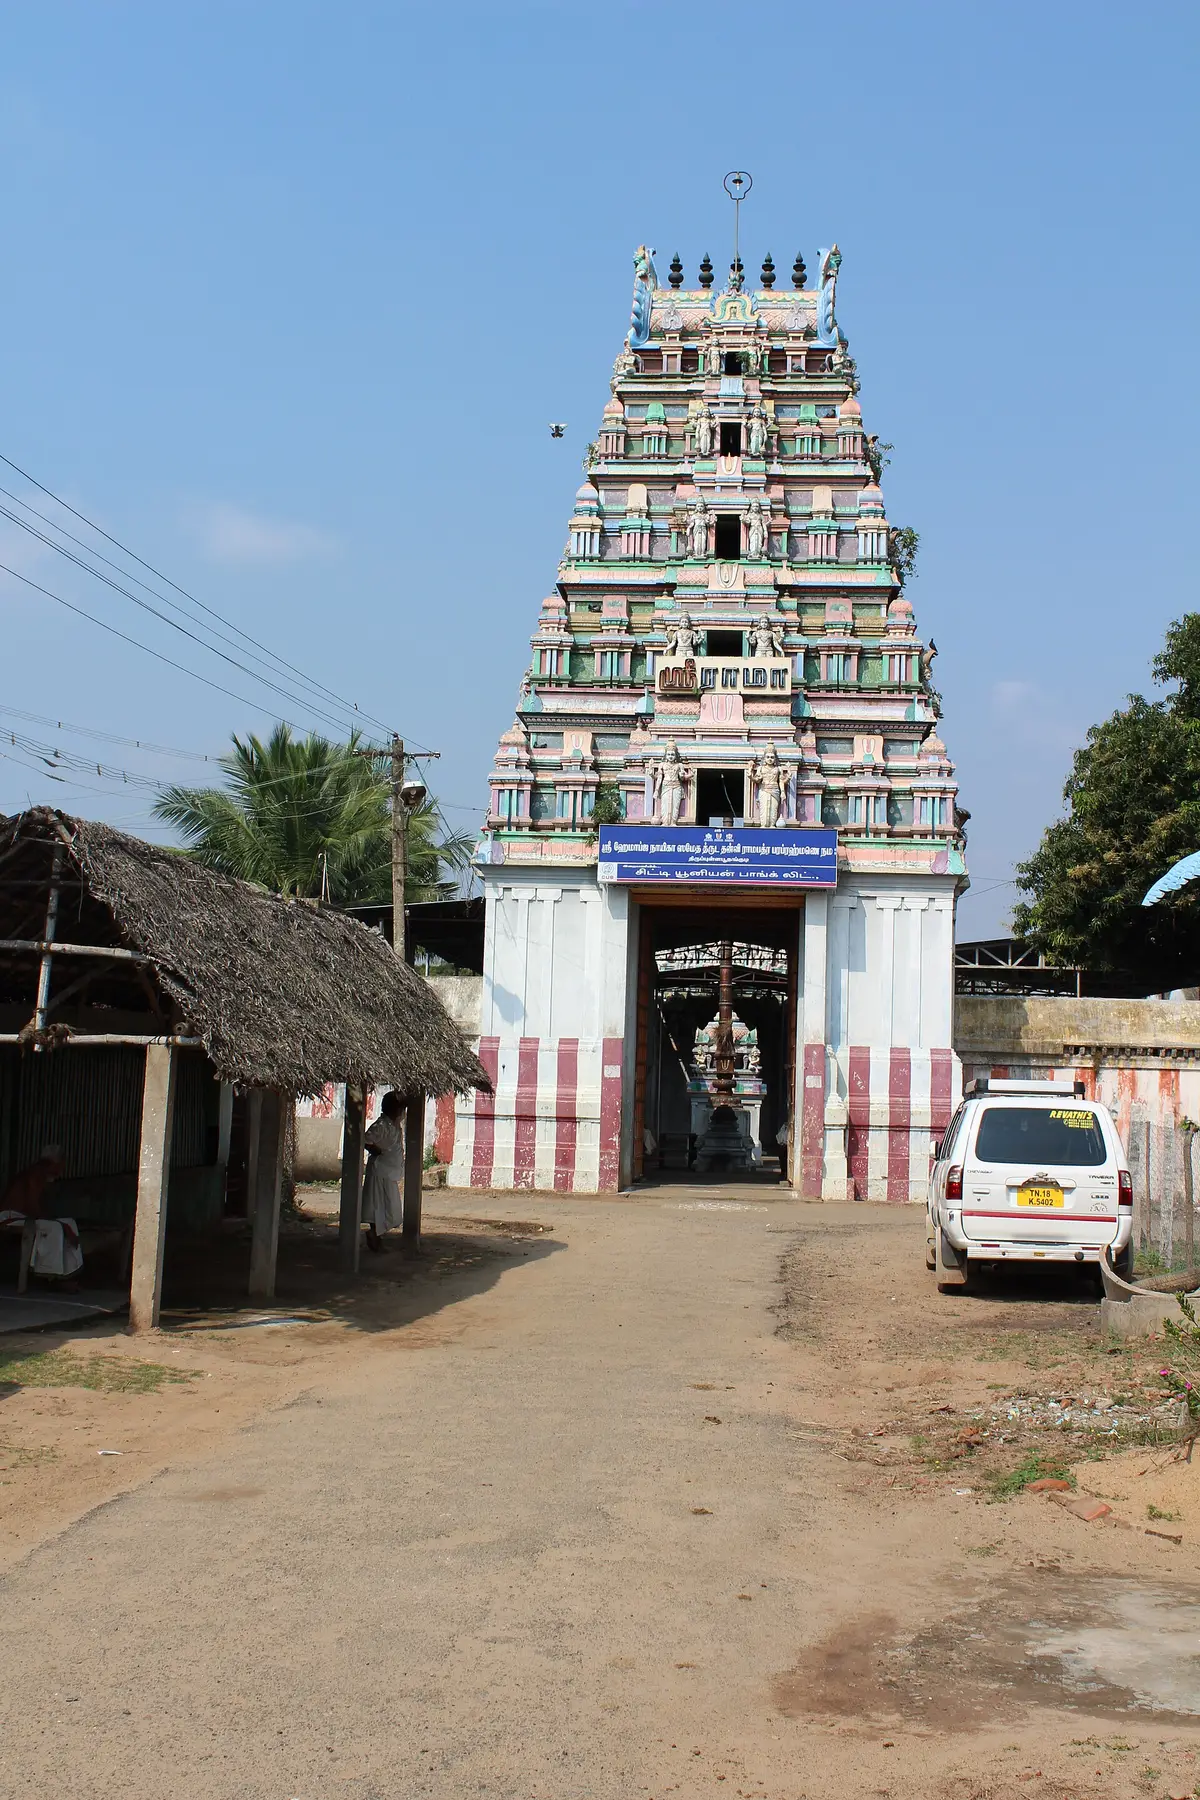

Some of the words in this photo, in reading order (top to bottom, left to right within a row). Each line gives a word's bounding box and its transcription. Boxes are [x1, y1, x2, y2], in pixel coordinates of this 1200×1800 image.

[700, 667, 788, 690] ராமா
[635, 868, 671, 878] சிட்டி
[675, 869, 736, 879] யூனியன்
[739, 870, 779, 879] பாங்க்
[1049, 1110, 1093, 1120] REVATHI'S
[1029, 1189, 1051, 1198] TN.18
[1028, 1198, 1054, 1206] K.5402
